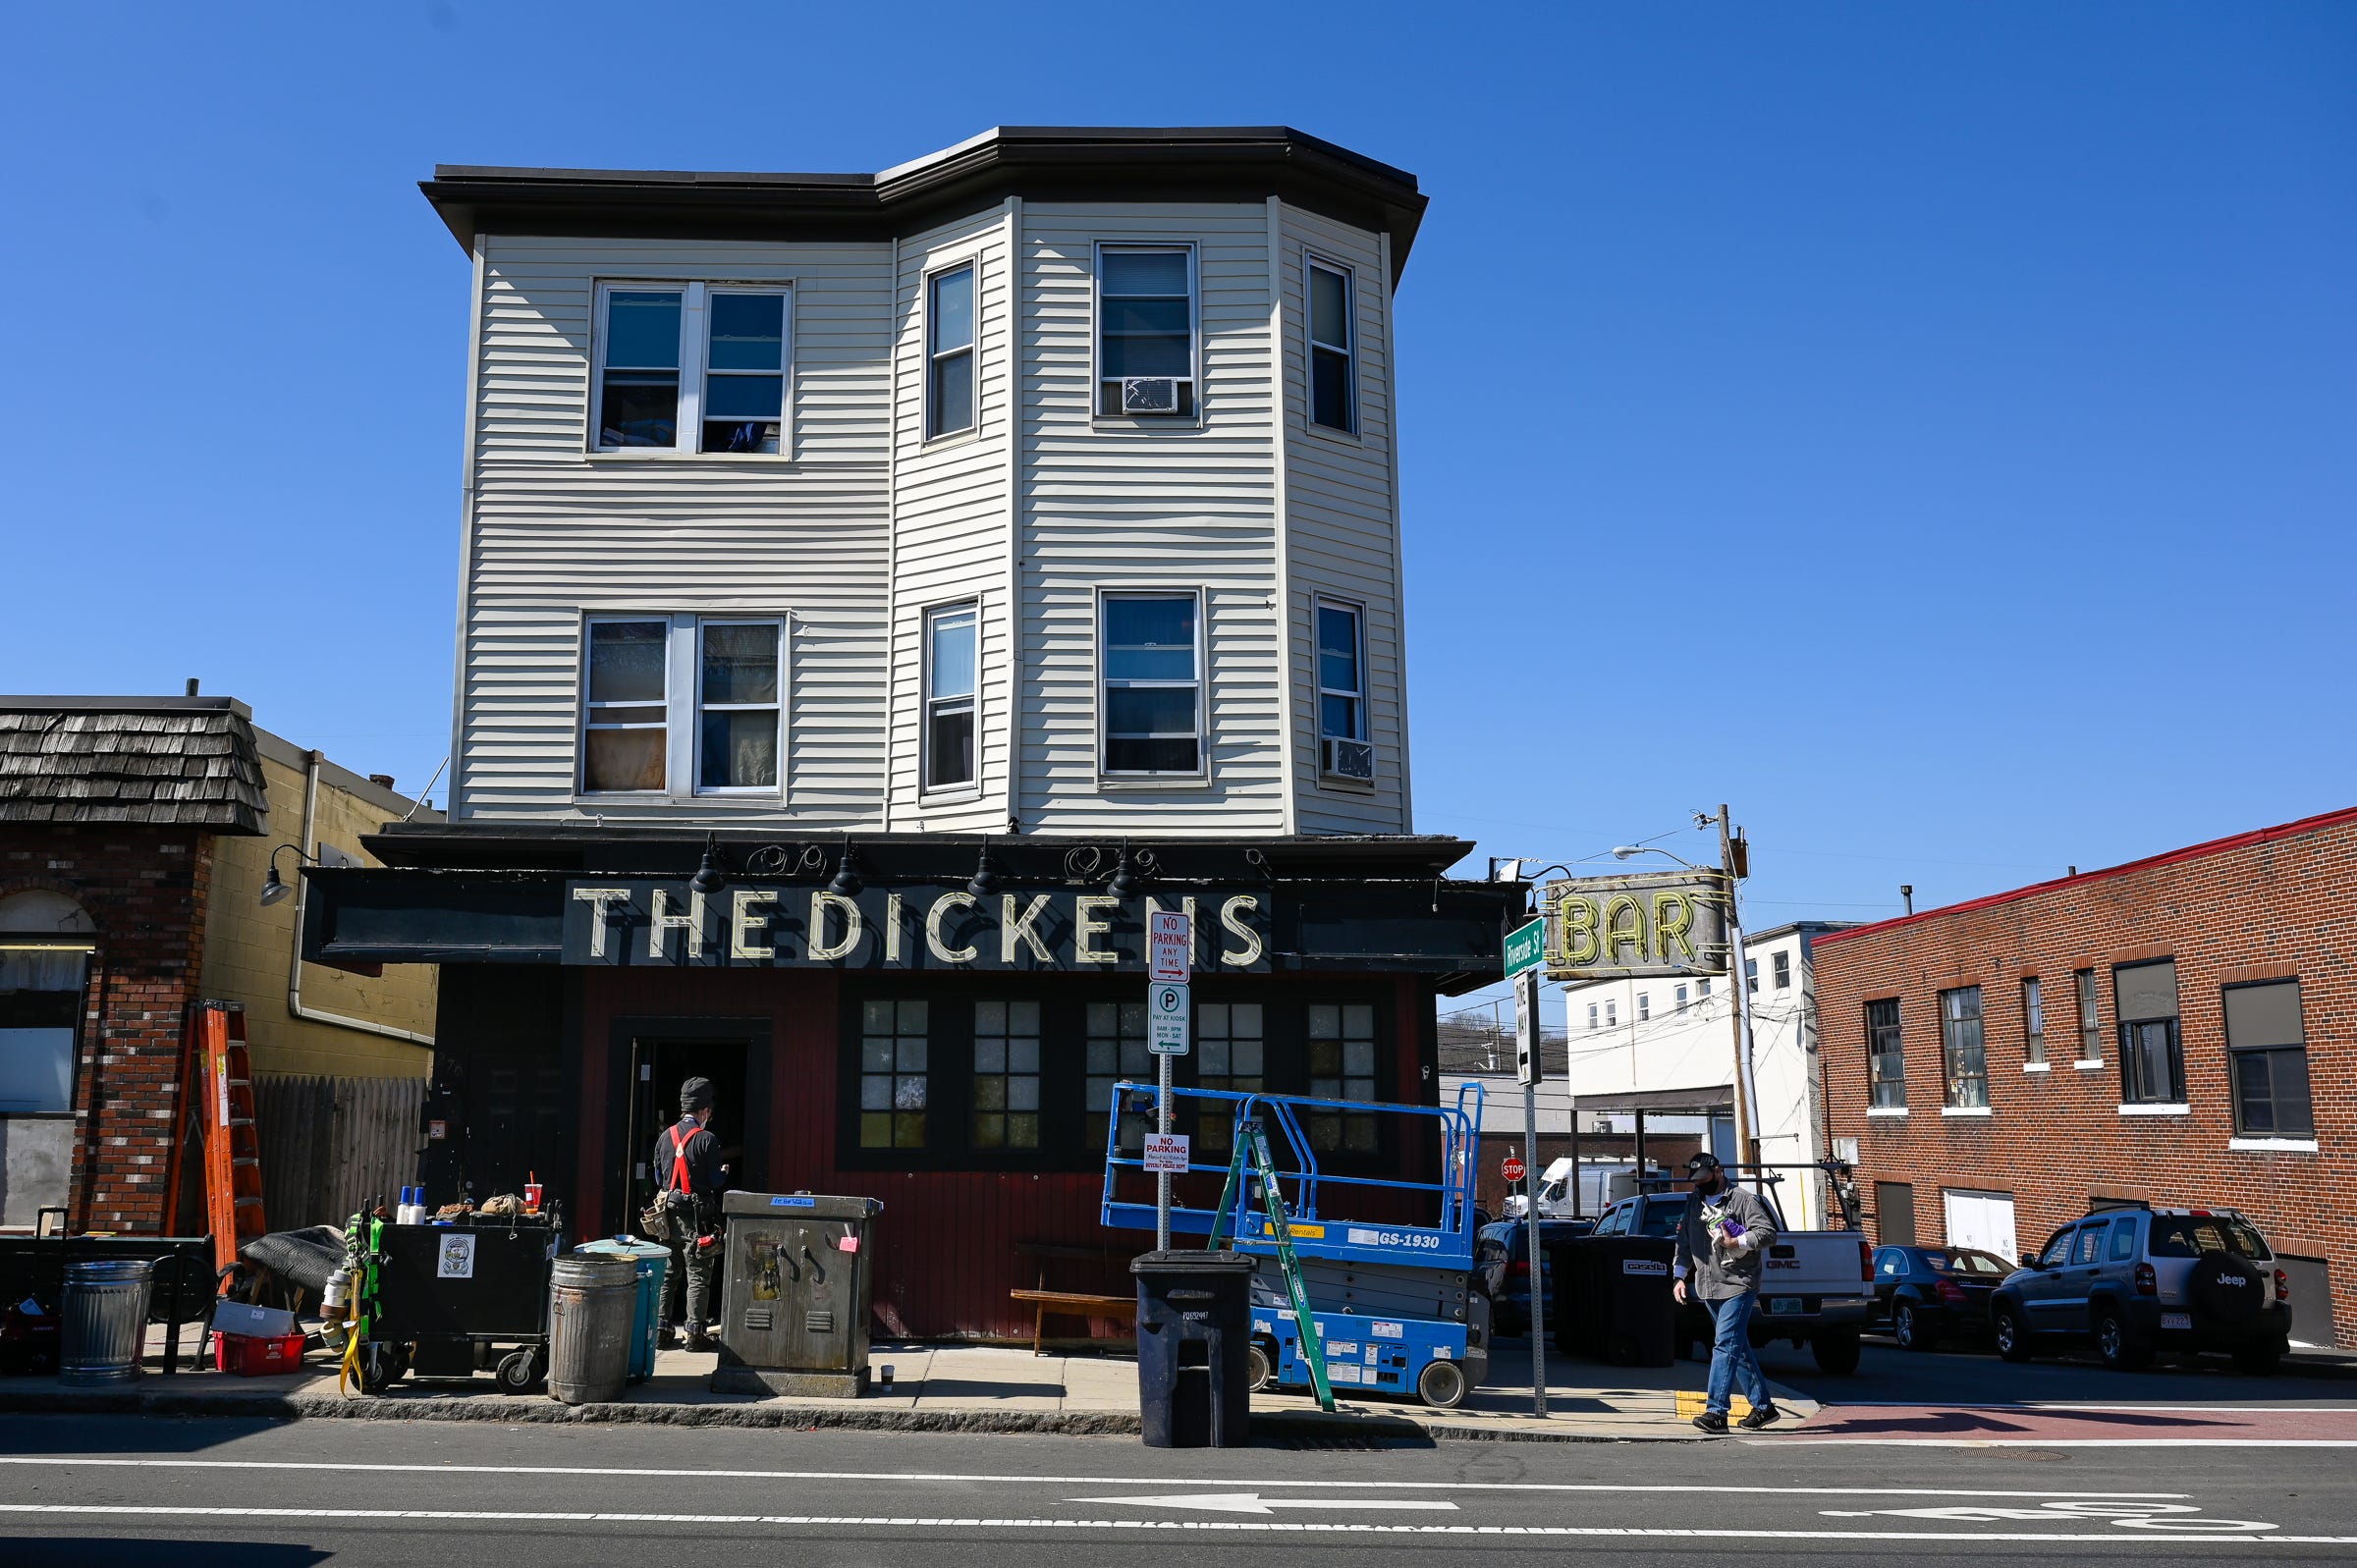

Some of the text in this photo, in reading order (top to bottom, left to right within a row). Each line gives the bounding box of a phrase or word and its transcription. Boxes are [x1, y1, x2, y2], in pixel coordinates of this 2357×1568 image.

[574, 889, 778, 959] THE
[1163, 918, 1178, 931] NO
[1562, 892, 1694, 963] BAR
[1153, 933, 1187, 946] PARKING
[1162, 947, 1178, 956] ANY
[1507, 929, 1540, 969] Riverside St
[1161, 958, 1179, 967] TIME
[1515, 982, 1526, 1008] ONE
[1147, 1145, 1186, 1153] PARKING
[1504, 1164, 1524, 1174] STOP
[1289, 1227, 1316, 1236] Rentals
[1379, 1233, 1440, 1249] GS-1930
[1627, 1262, 1667, 1272] casella
[1766, 1260, 1800, 1269] GMC
[2217, 1272, 2246, 1287] Jeep
